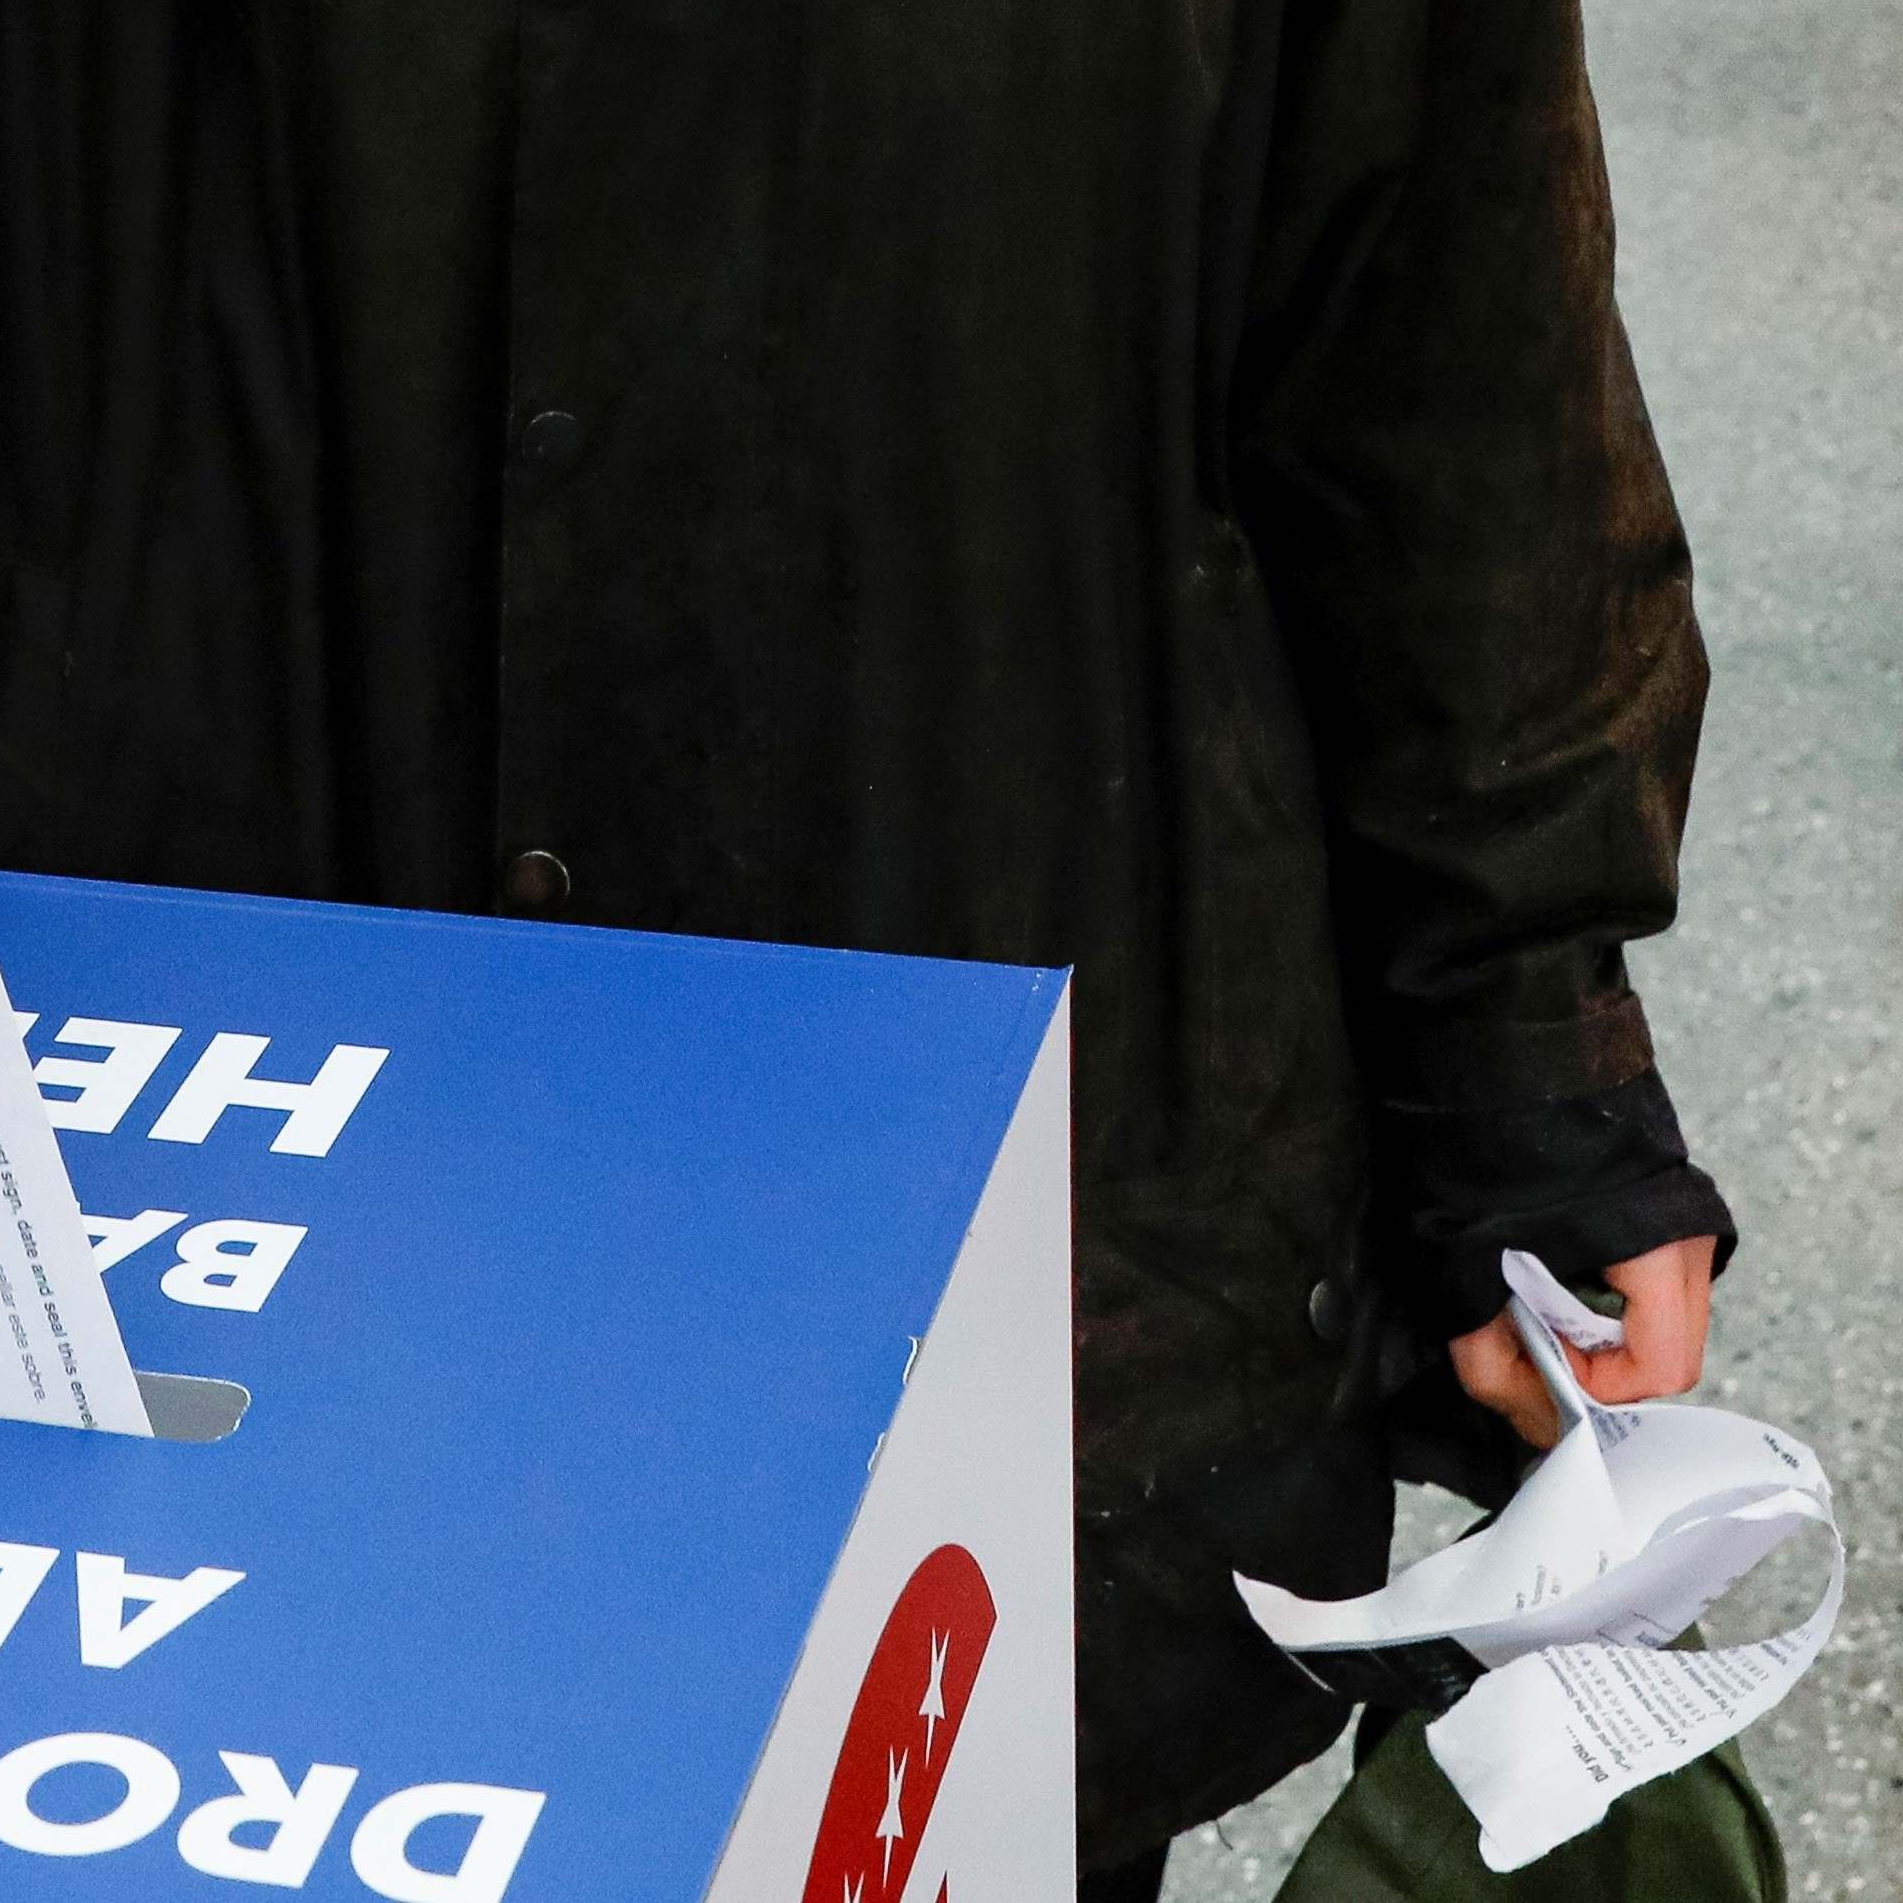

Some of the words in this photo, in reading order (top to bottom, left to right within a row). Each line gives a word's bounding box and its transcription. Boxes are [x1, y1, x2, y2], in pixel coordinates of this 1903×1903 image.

[13, 1010, 391, 1158] HE
[16, 1216, 42, 1260] date
[30, 1260, 55, 1298] and
[42, 1299, 68, 1339] seal
[6, 1311, 30, 1350] este
[19, 1350, 49, 1405] sobre.
[57, 1339, 80, 1376] this
[1585, 1763, 1609, 1783] Did
